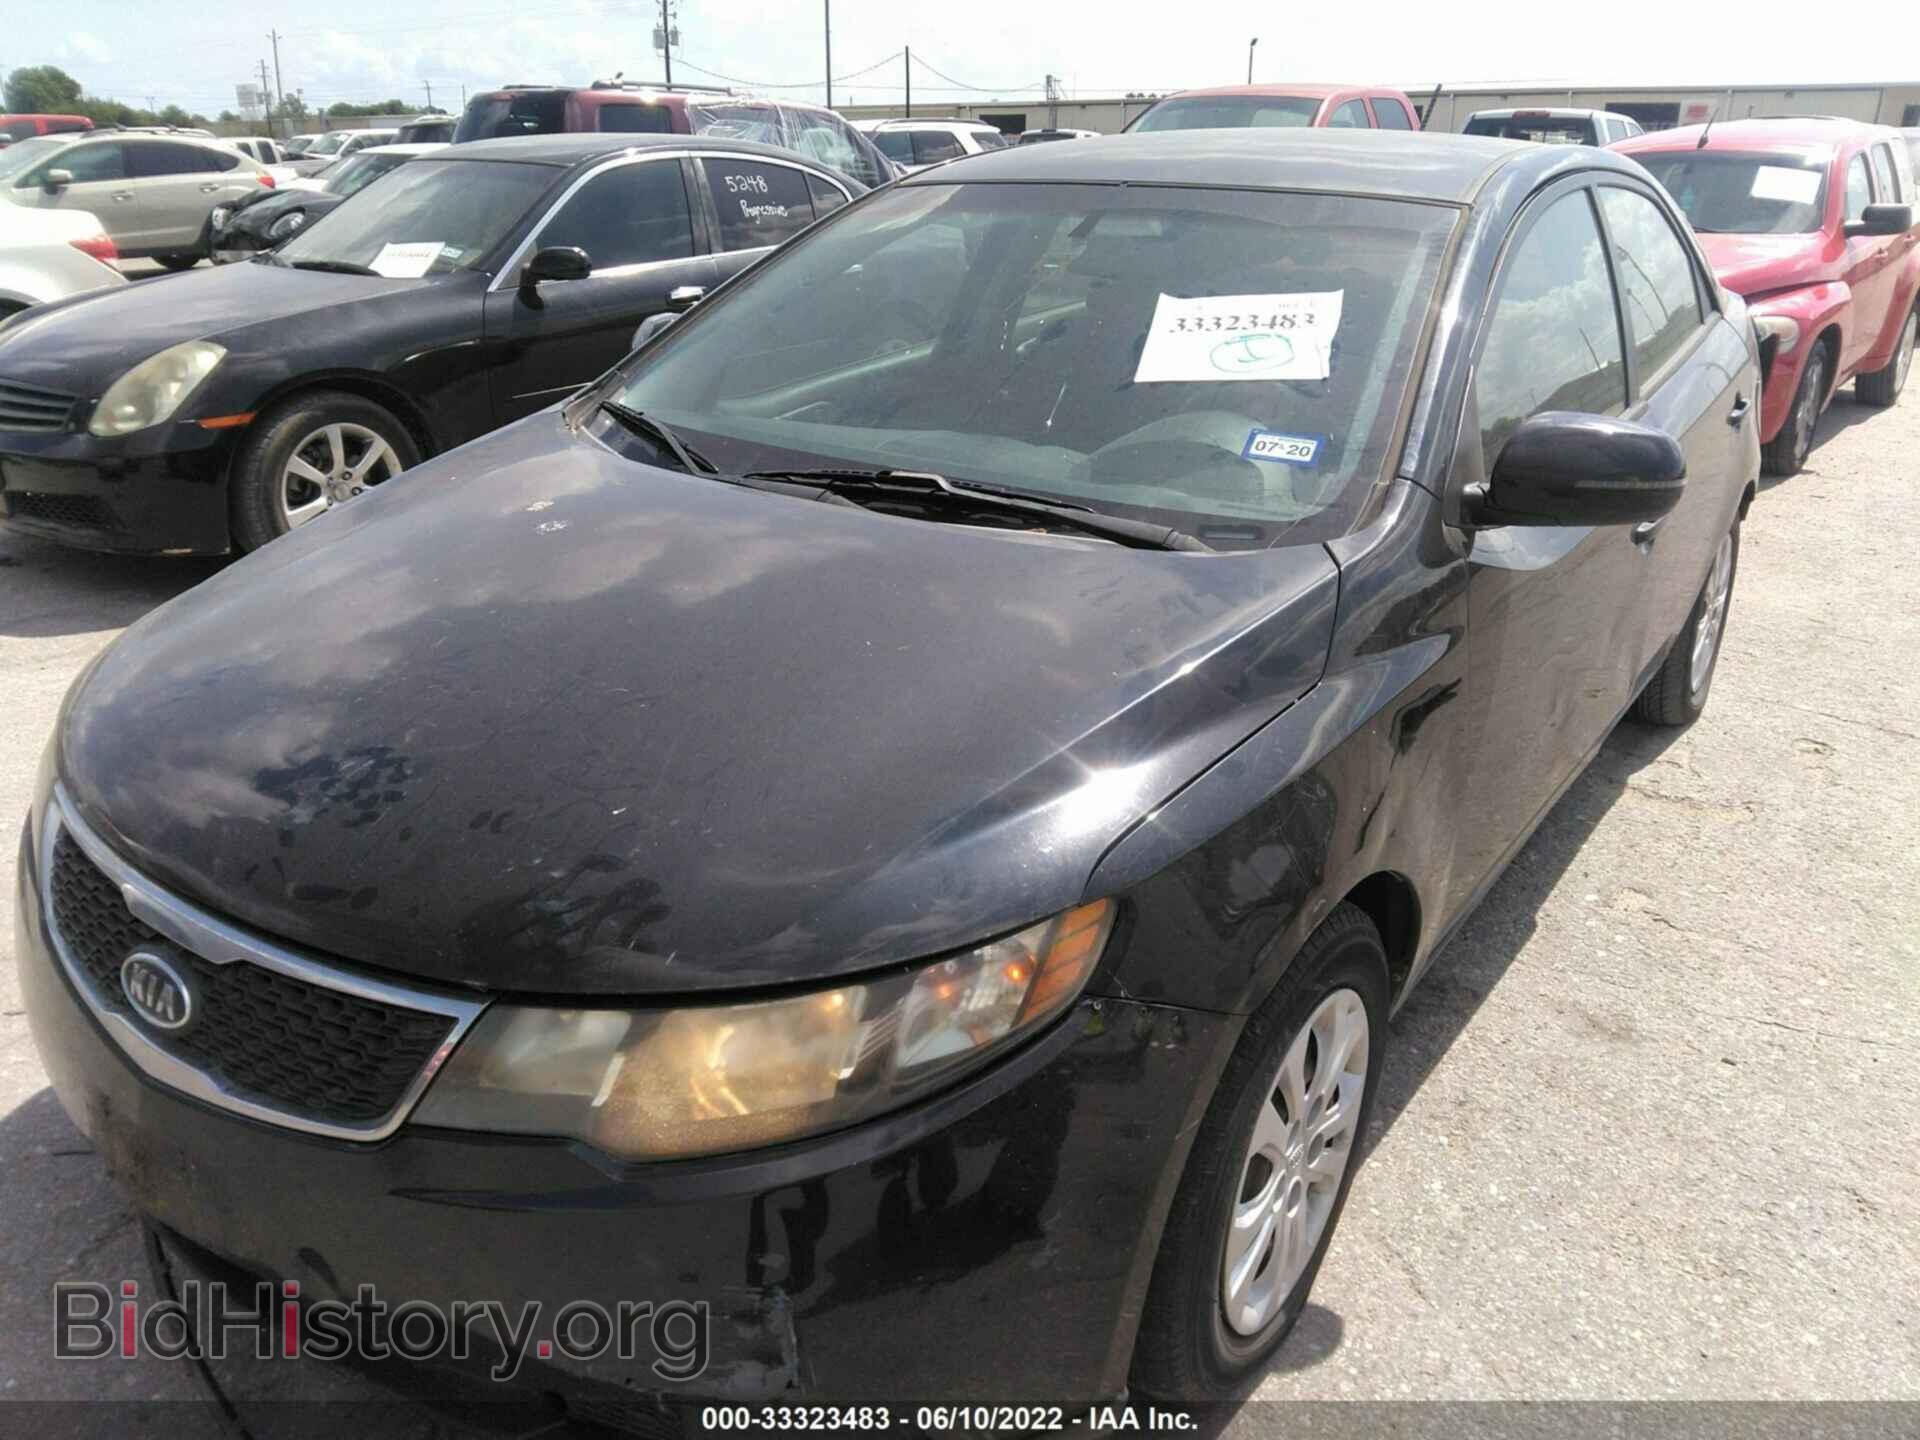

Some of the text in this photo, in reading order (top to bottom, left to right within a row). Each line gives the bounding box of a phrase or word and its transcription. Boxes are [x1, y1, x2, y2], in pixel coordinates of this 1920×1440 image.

[724, 174, 769, 193] 5248
[1168, 313, 1317, 334] 33323483
[1254, 440, 1279, 453] 07
[1286, 444, 1311, 457] 20
[130, 962, 175, 1021] KIA
